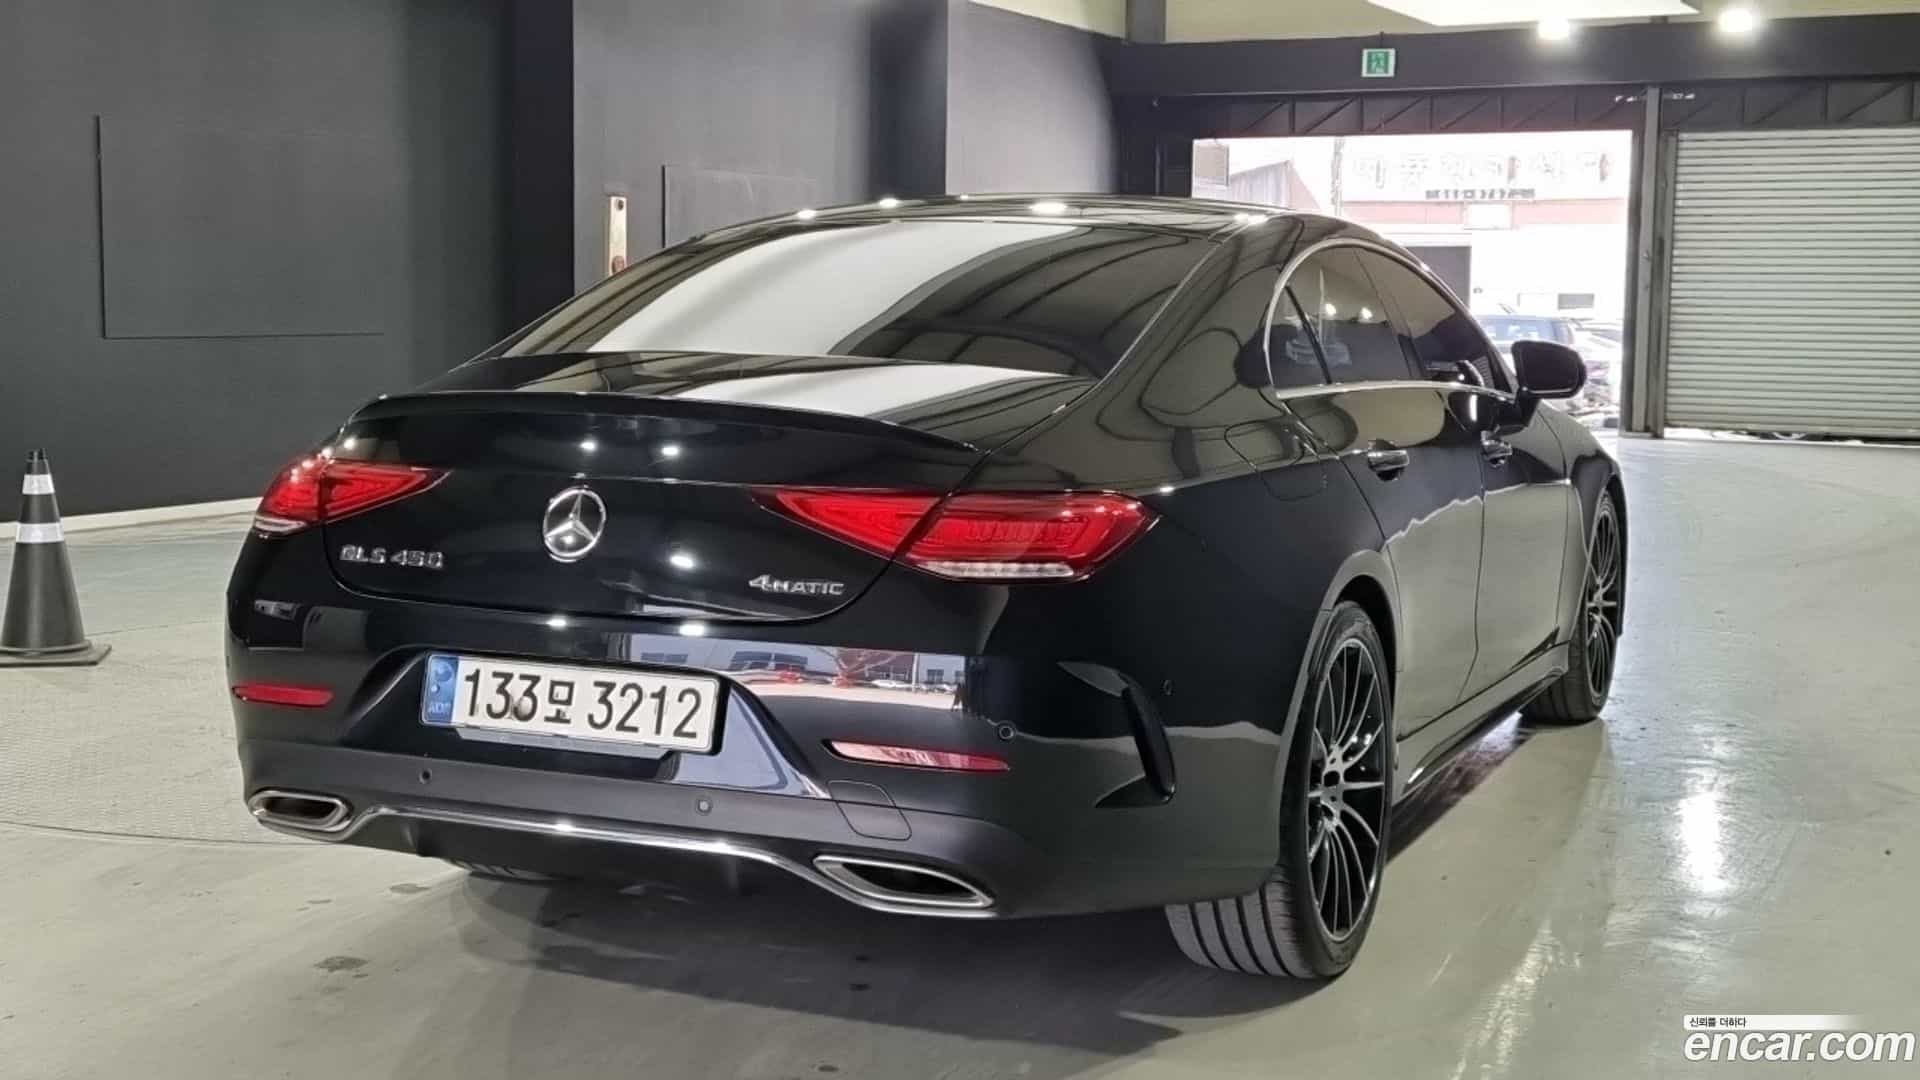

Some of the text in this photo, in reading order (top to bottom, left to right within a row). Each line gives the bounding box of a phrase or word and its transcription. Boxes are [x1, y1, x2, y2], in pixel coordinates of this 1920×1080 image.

[390, 549, 443, 568] 450
[748, 574, 844, 595] 4MATIC
[587, 680, 702, 739] 3212
